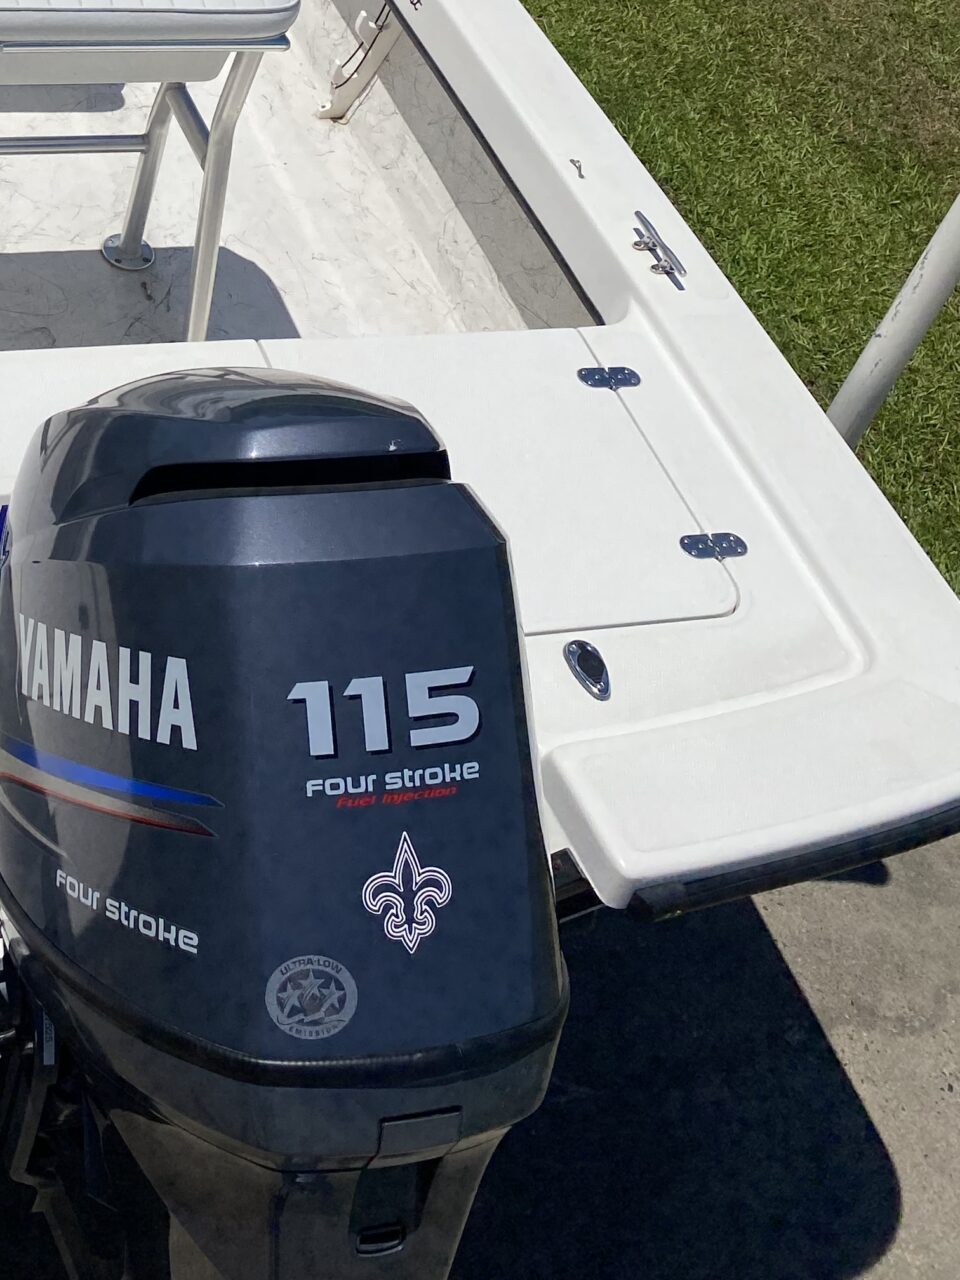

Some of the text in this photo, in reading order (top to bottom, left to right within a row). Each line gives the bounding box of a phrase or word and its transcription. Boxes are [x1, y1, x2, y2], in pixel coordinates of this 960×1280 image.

[19, 613, 198, 751] YAMAHA
[286, 665, 483, 760] 115
[336, 785, 457, 808] Fuel Injection
